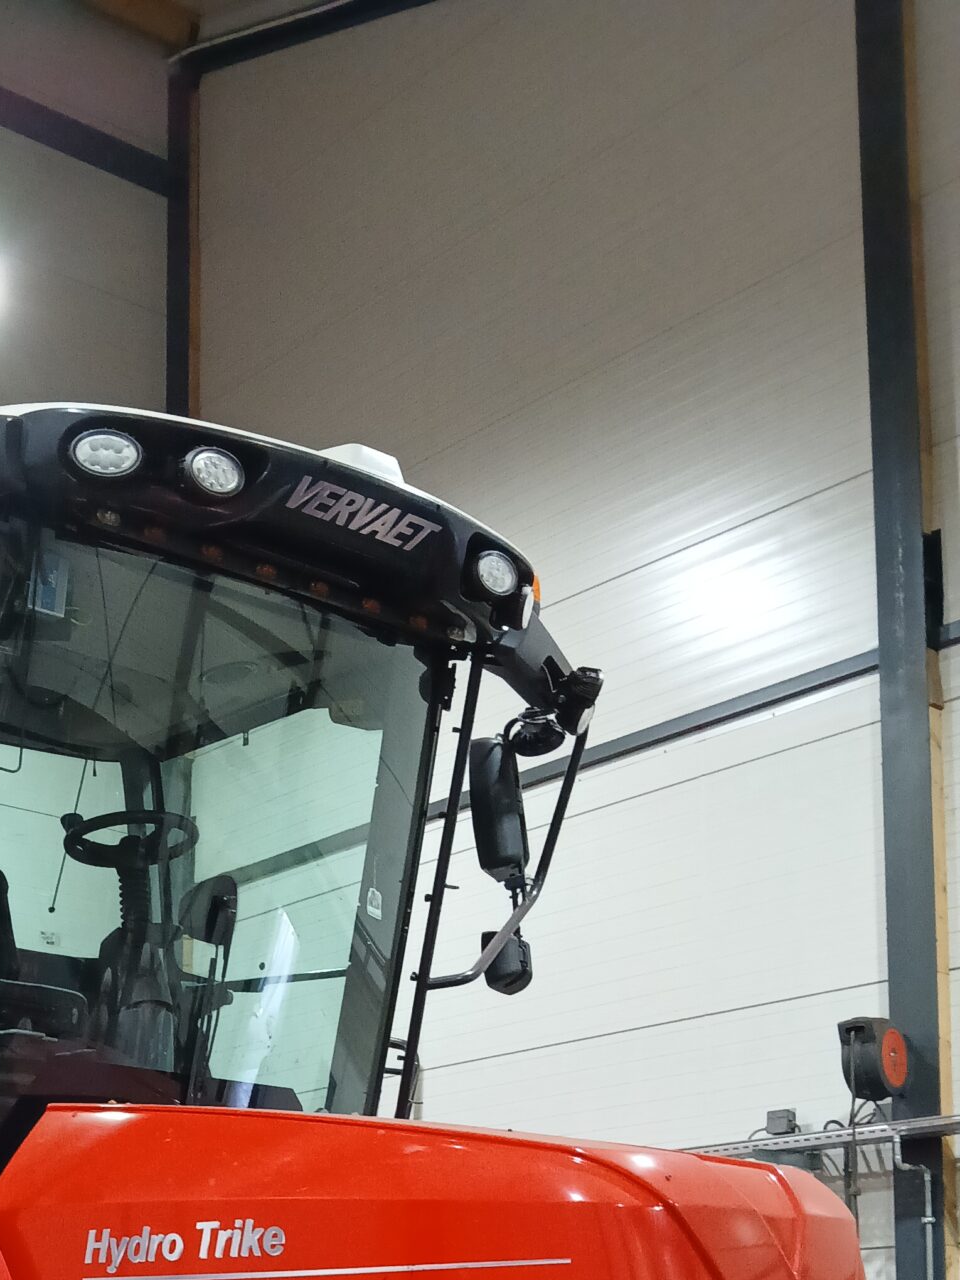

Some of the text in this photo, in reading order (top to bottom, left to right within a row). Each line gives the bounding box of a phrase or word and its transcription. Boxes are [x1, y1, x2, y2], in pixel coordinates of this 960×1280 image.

[285, 475, 442, 551] VERVAET
[84, 1218, 286, 1274] Hydro Trike
